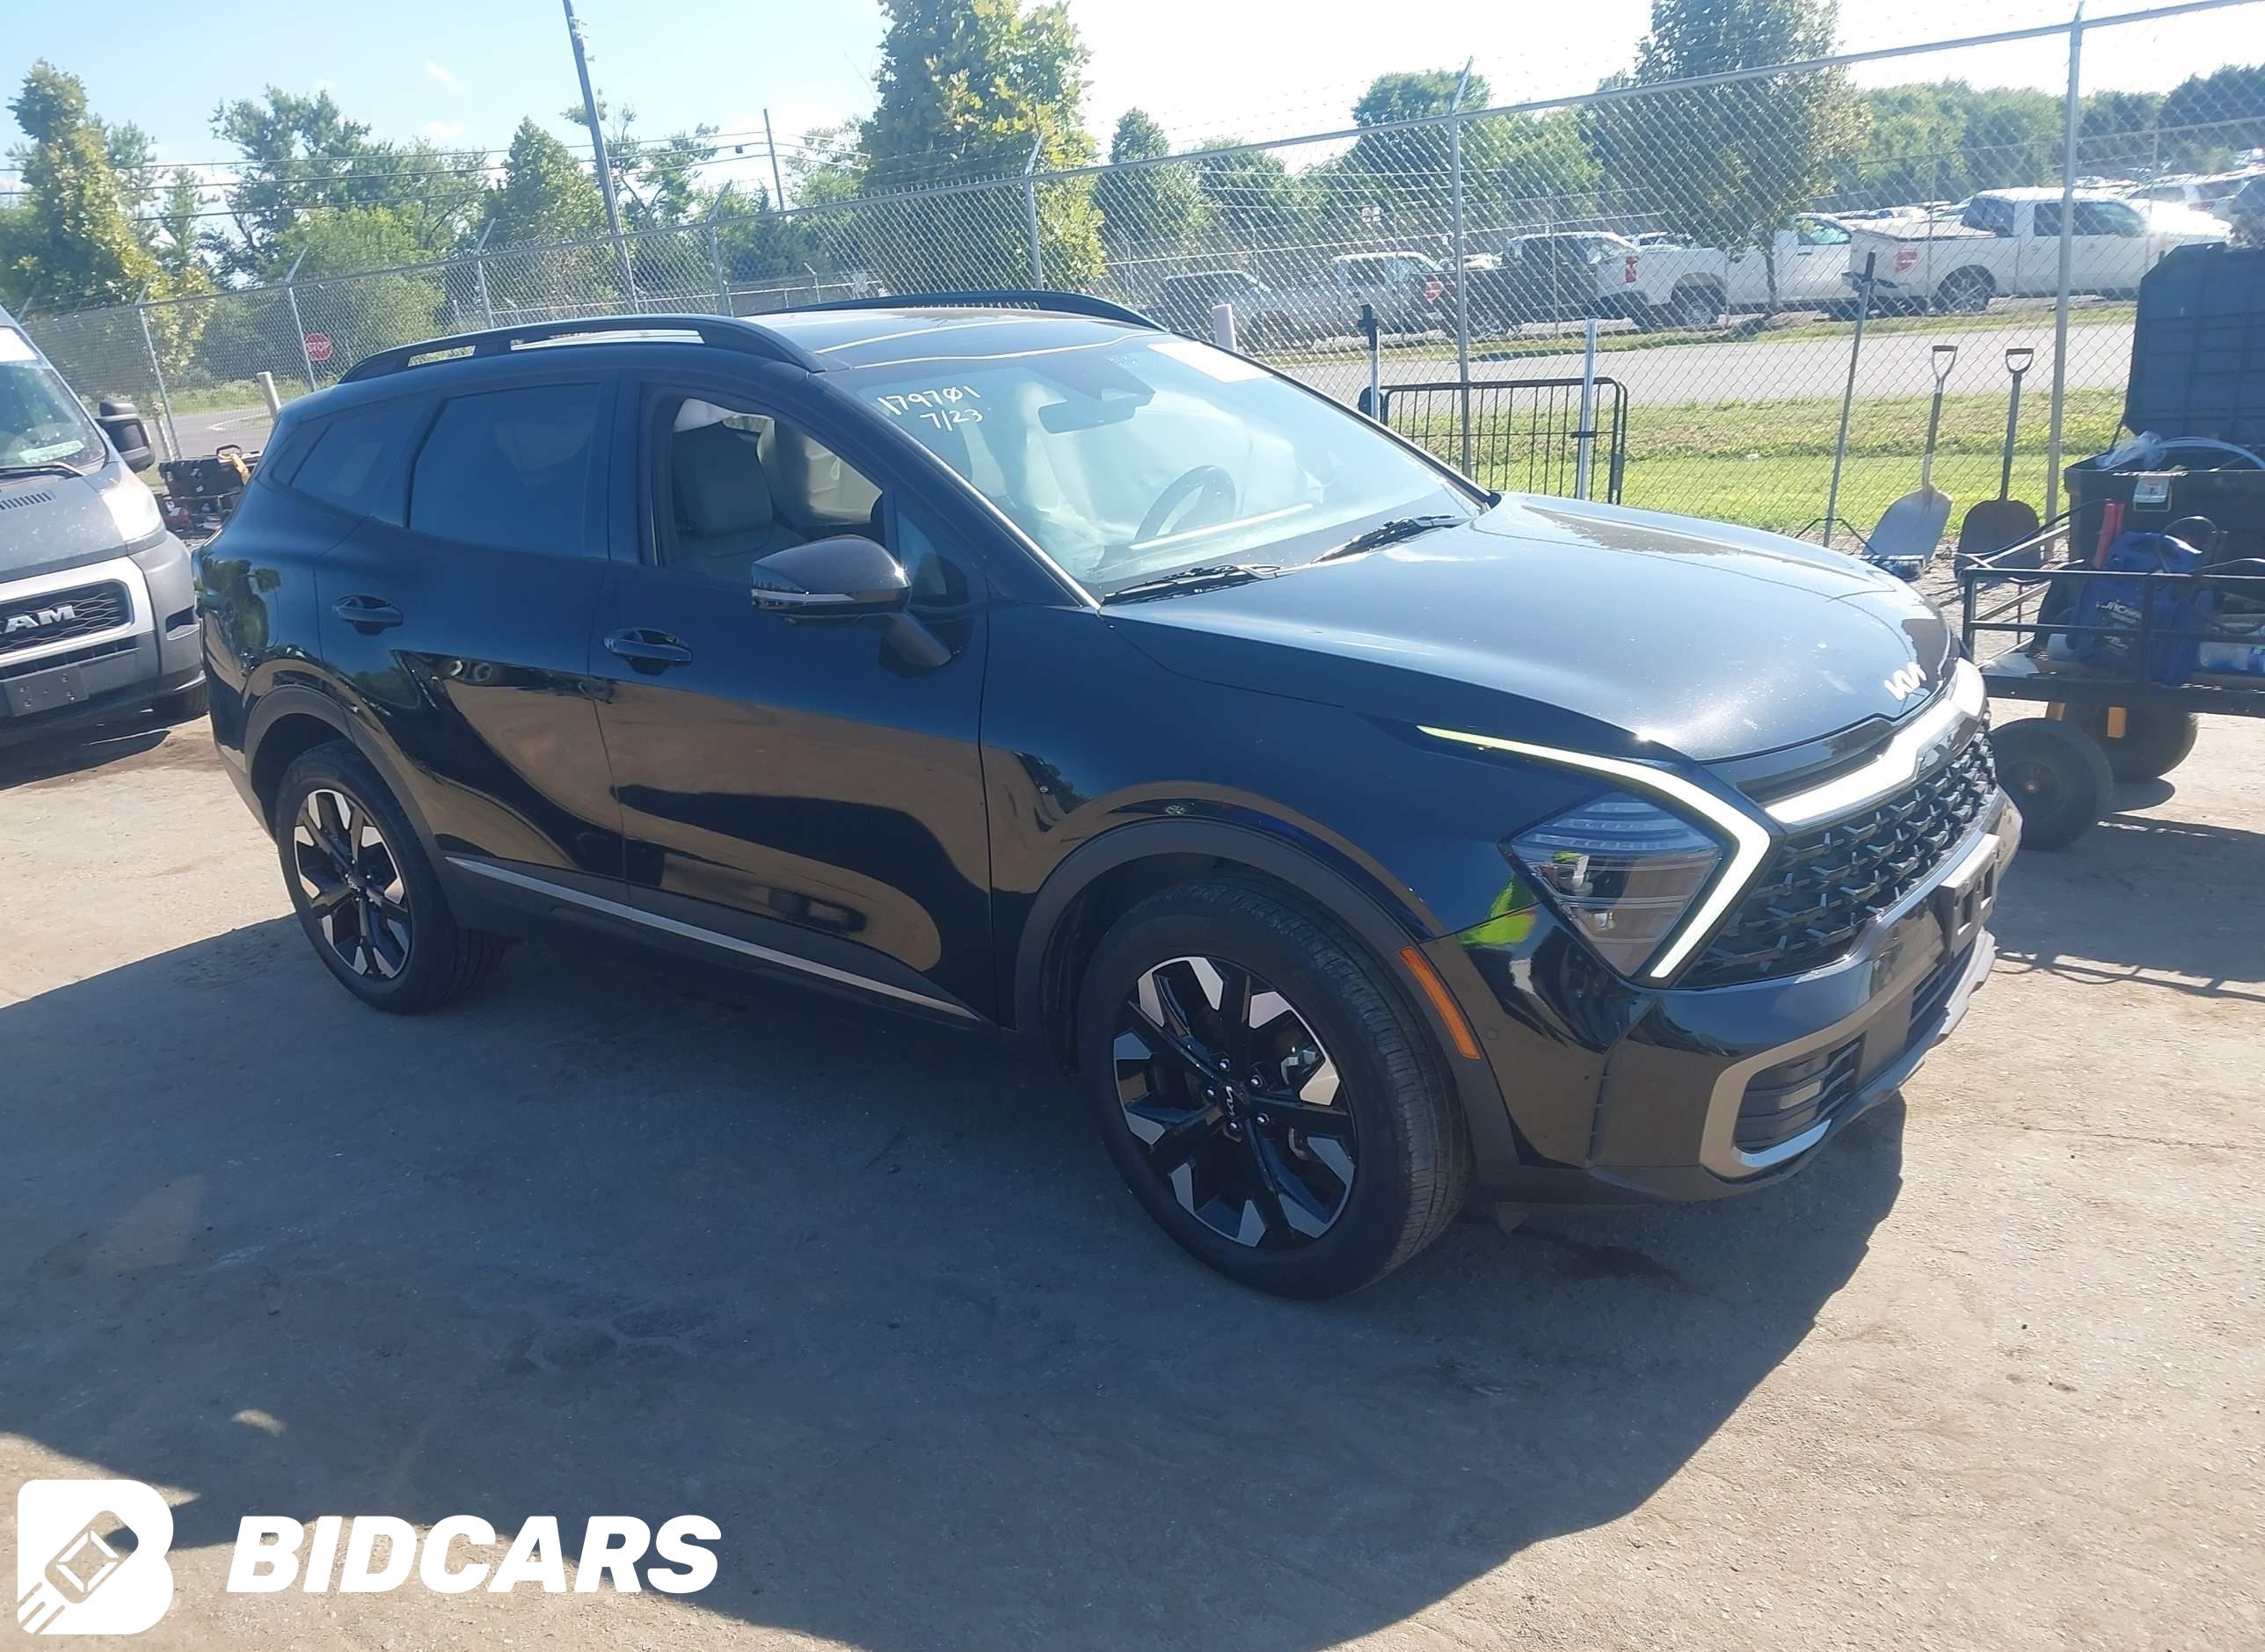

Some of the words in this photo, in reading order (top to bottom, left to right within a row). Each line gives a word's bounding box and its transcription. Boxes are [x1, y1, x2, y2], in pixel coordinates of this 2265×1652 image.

[306, 341, 331, 353] STOP
[878, 385, 981, 416] 179701
[920, 409, 984, 432] 7/23
[0, 604, 76, 634] AM
